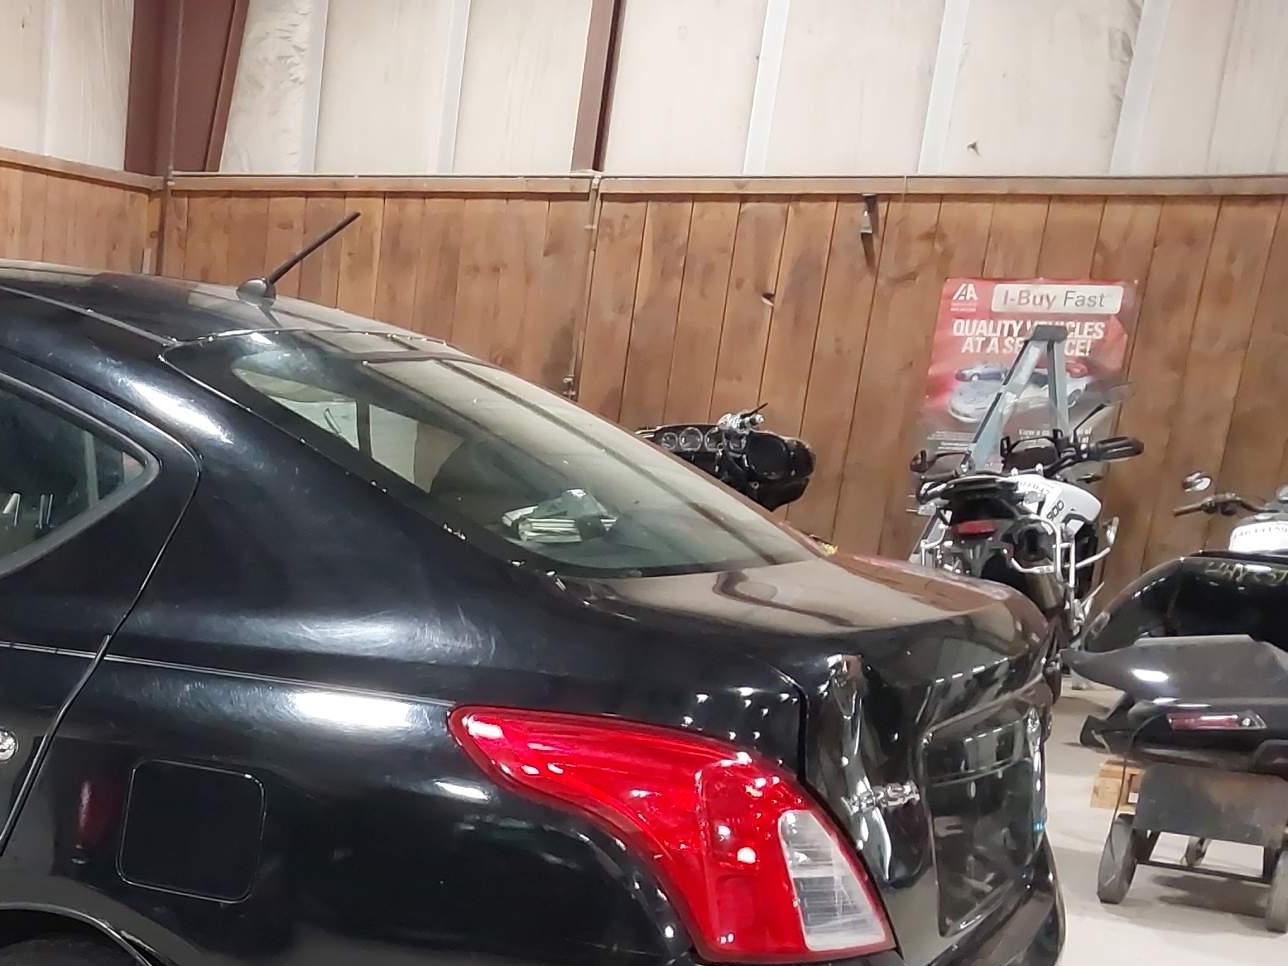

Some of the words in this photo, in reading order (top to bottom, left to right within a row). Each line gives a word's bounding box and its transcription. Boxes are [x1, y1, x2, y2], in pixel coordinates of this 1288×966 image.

[1003, 289, 1056, 310] I-Buy
[1063, 290, 1105, 308] Fast
[952, 319, 1024, 337] QUALITY
[1026, 320, 1105, 340] VCLES
[962, 337, 982, 353] AT
[986, 337, 1000, 354] A
